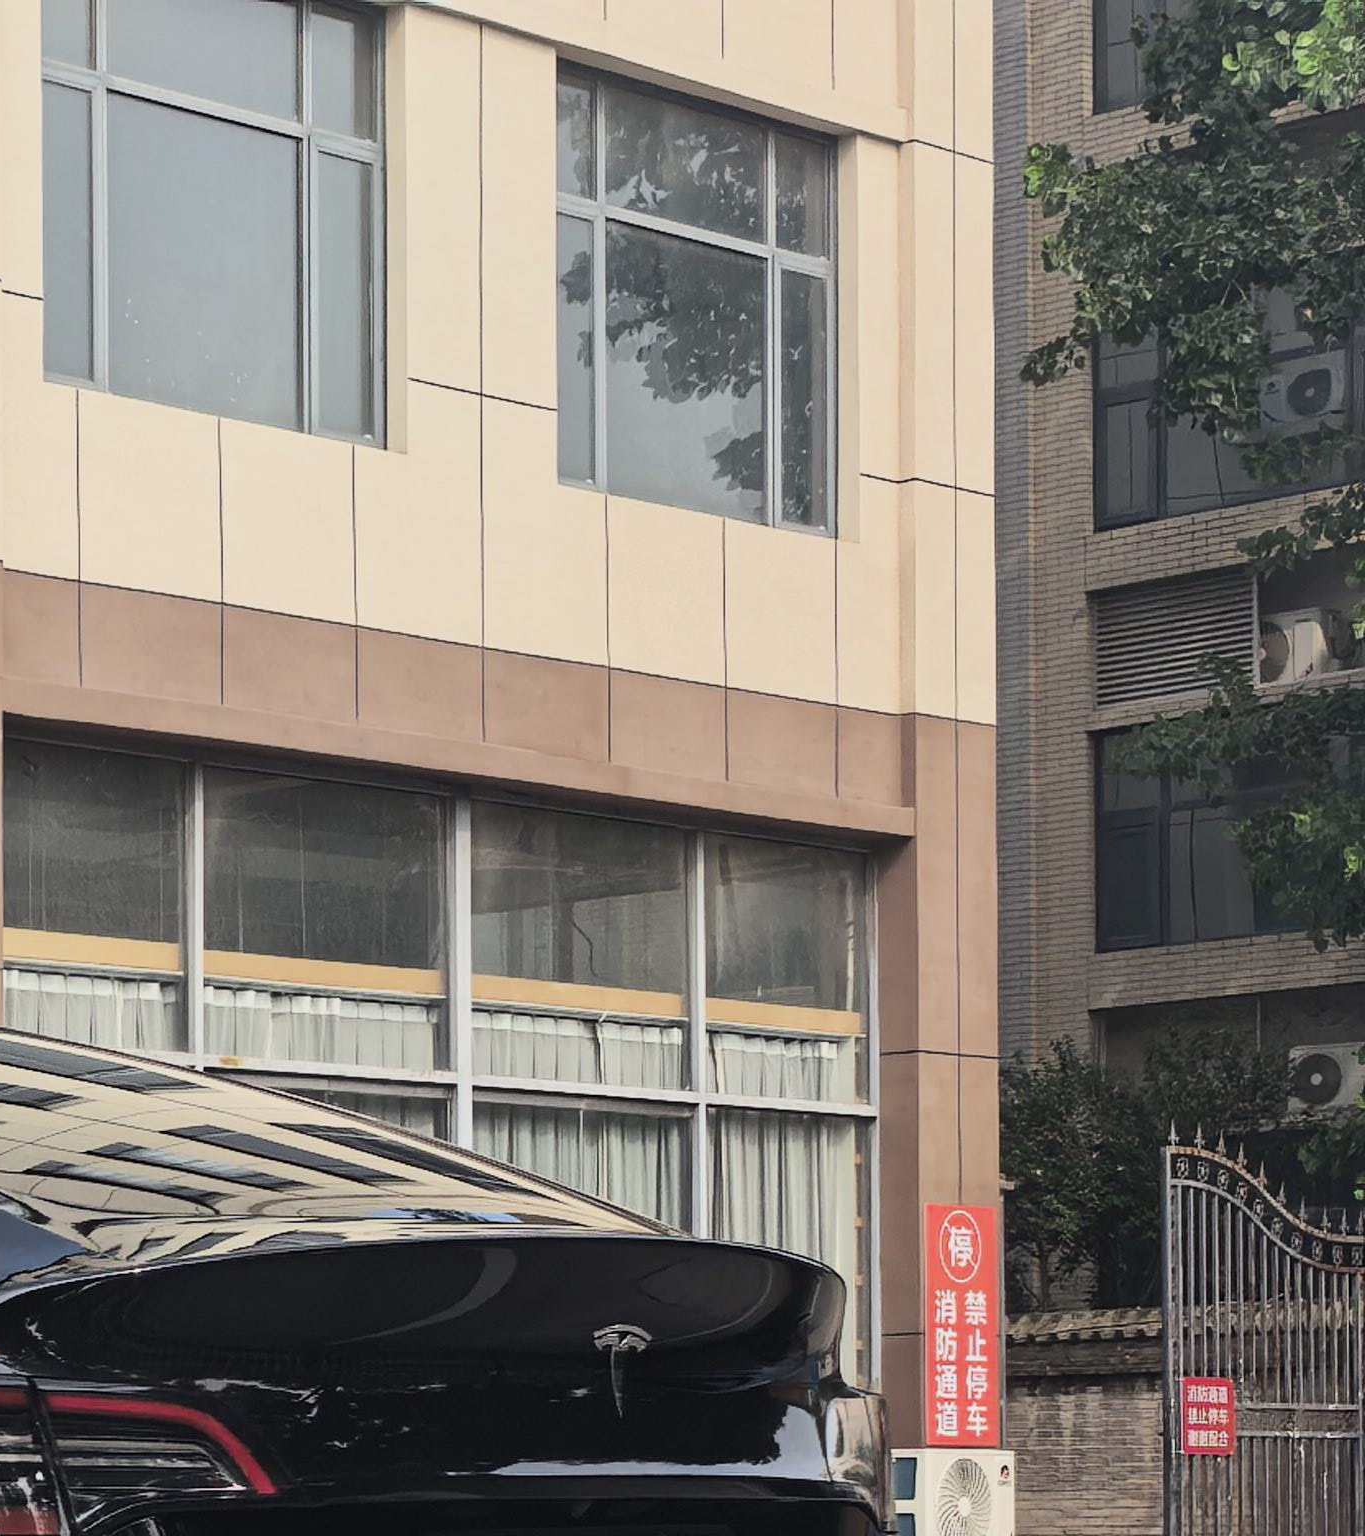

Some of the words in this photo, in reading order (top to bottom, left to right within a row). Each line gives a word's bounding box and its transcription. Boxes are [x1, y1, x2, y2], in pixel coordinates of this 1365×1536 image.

[934, 1290, 959, 1437] 消防通道
[965, 1290, 989, 1438] 禁止停车
